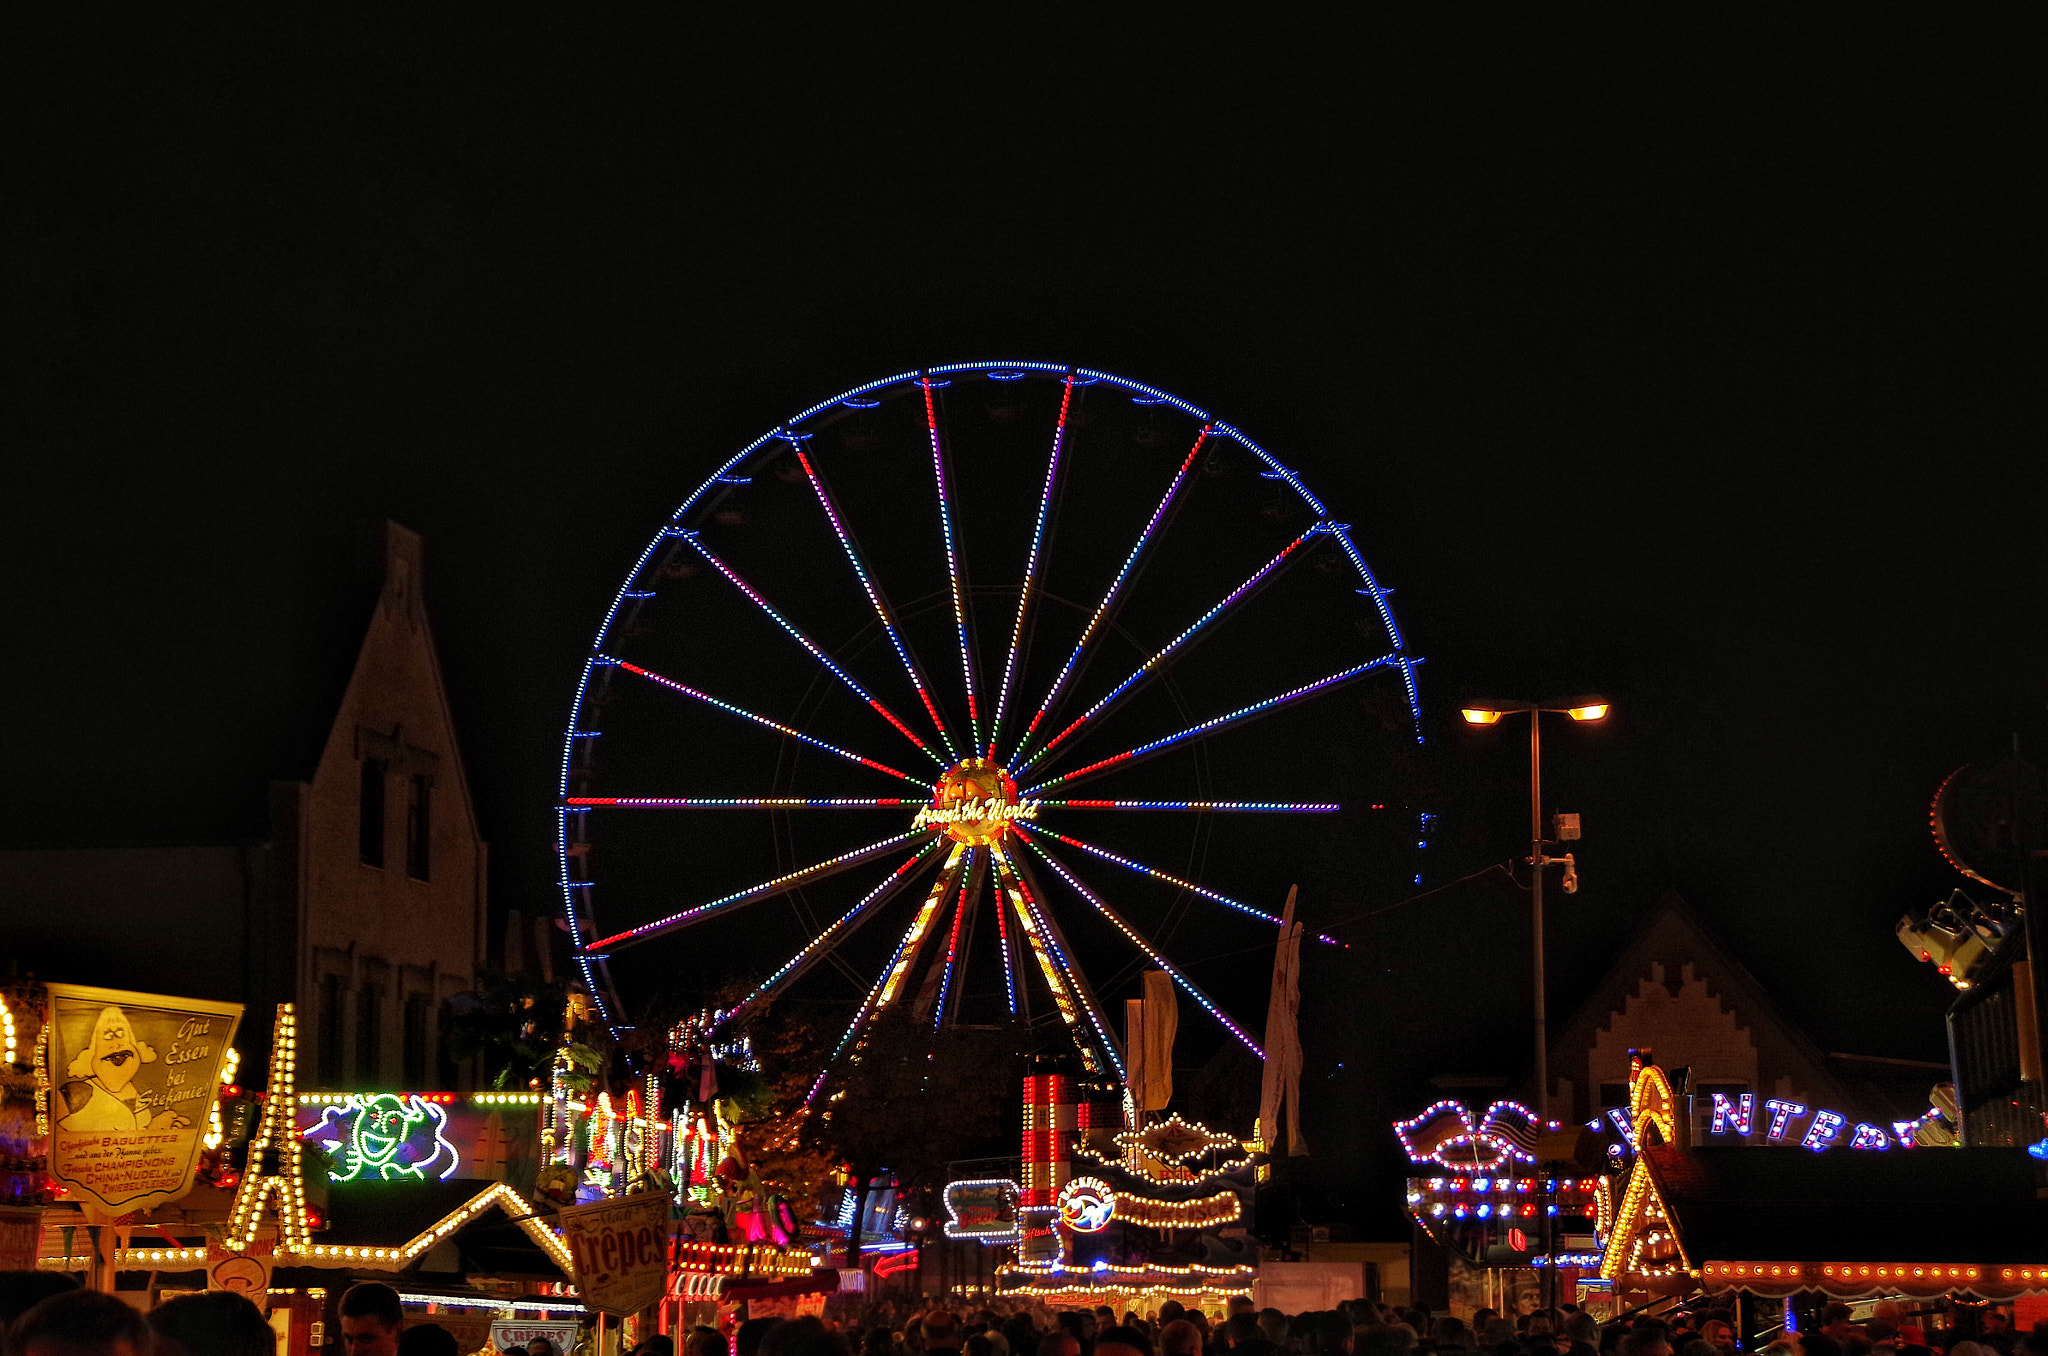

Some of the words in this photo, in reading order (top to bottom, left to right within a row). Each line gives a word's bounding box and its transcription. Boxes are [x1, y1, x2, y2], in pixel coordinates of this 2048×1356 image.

[910, 799, 961, 829] Around
[961, 796, 985, 820] the
[985, 797, 1040, 820] World
[177, 1017, 211, 1044] Gut
[165, 1042, 209, 1065] Essen
[166, 1068, 187, 1087] bei
[133, 1082, 209, 1110] Stefanie!
[102, 1134, 178, 1147] BAGUETTES
[94, 1157, 176, 1173] CHAMPIGNONS
[101, 1178, 178, 1195] ZWIEBELFLEISCH
[1059, 1176, 1115, 1204] BACKFISCH
[572, 1224, 664, 1276] Crêpes
